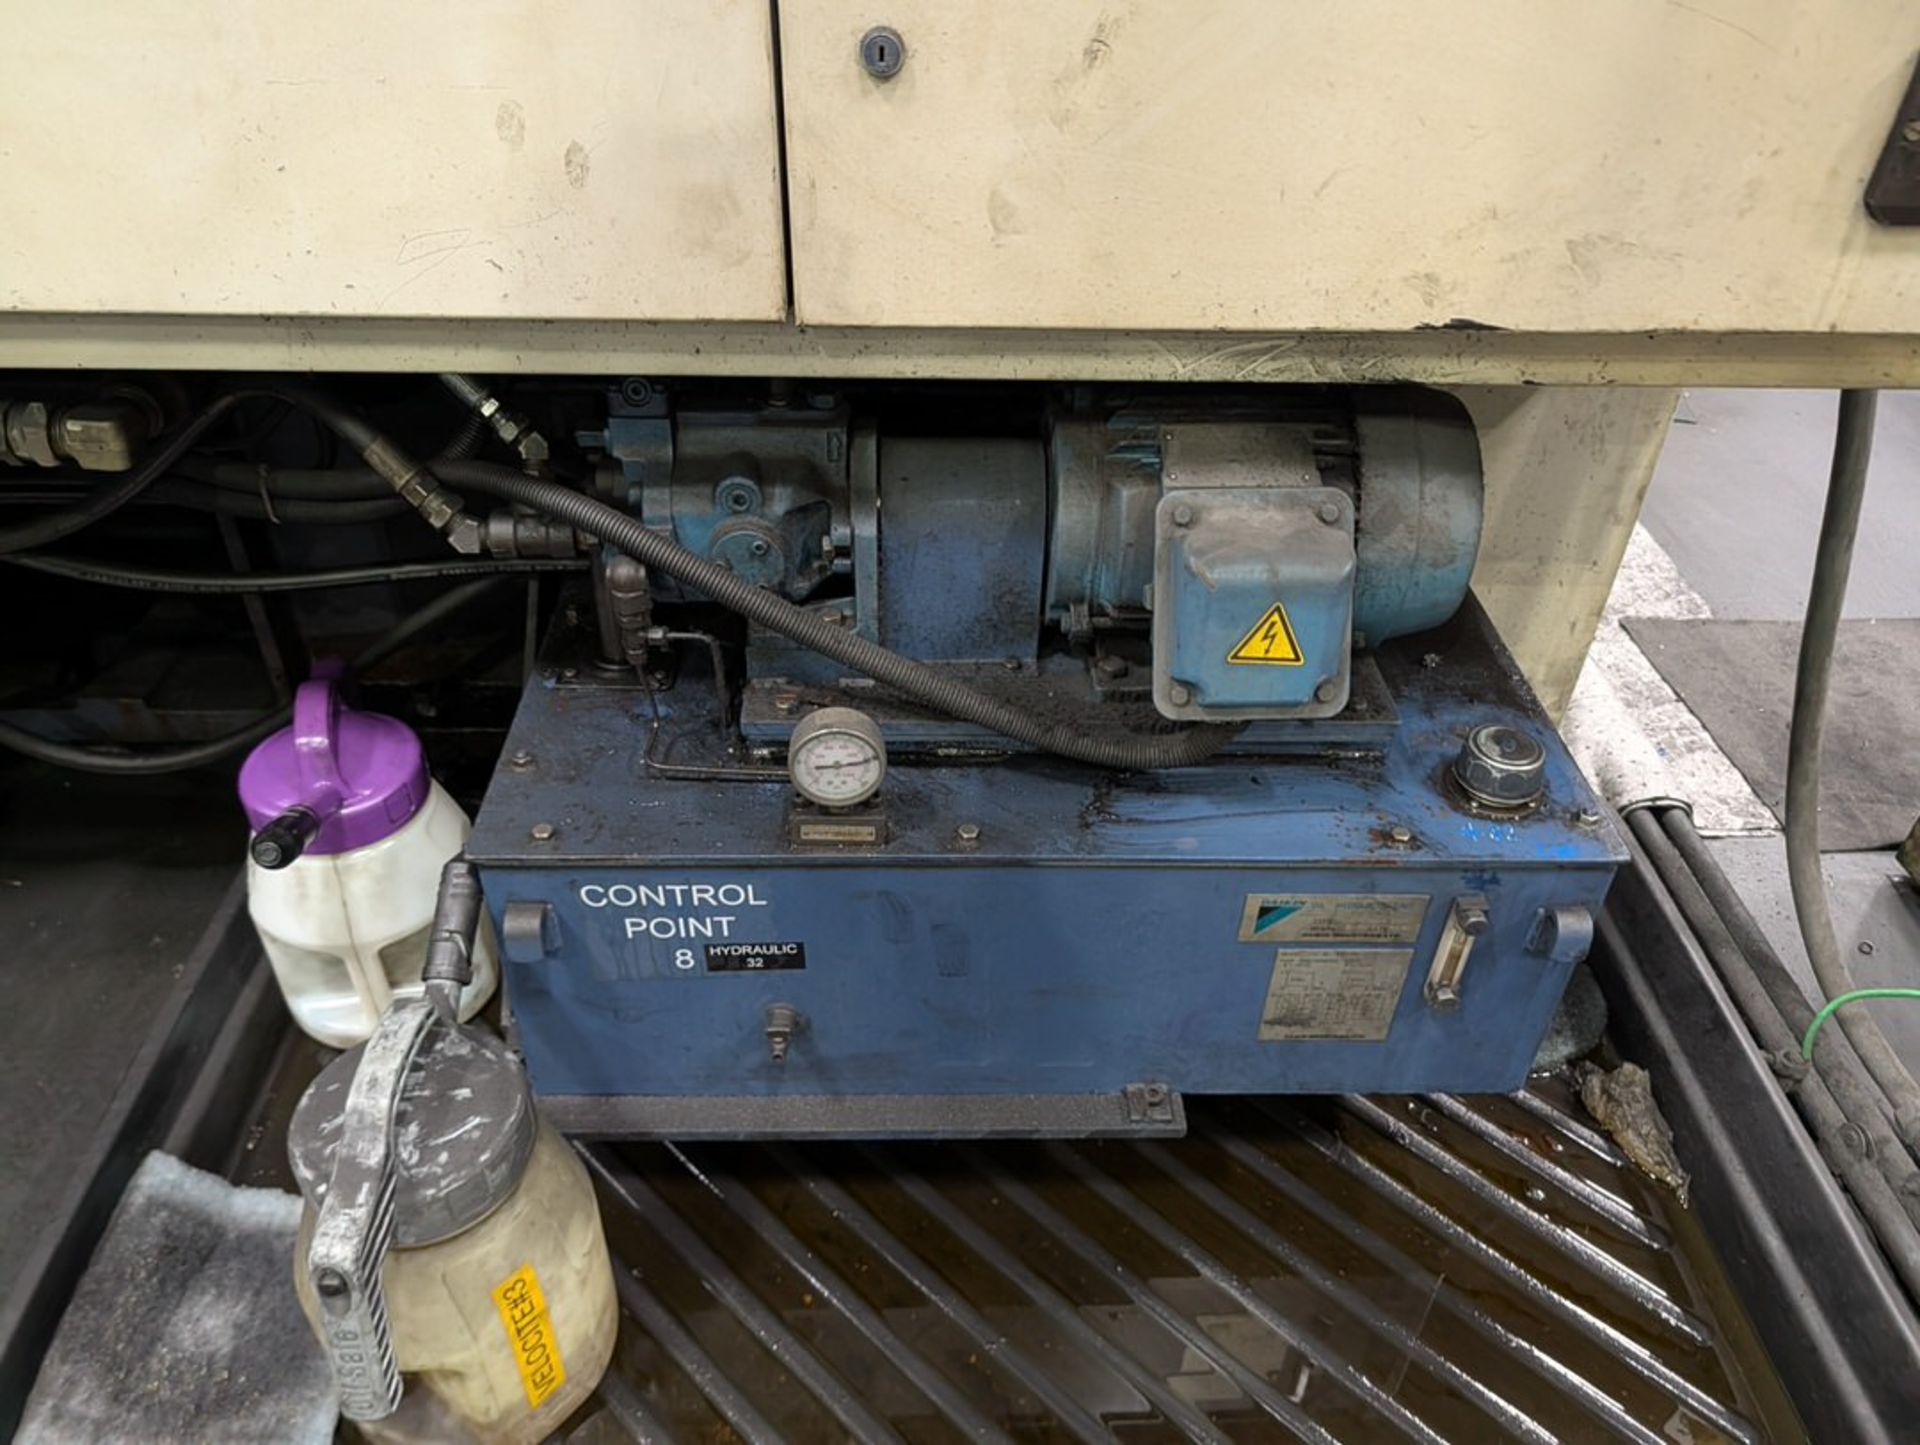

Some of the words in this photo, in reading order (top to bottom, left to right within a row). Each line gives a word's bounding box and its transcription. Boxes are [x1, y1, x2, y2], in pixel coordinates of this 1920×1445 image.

[580, 884, 768, 908] CONTROL
[624, 916, 736, 939] POINT
[675, 948, 695, 969] 8
[709, 943, 798, 956] HYDRAULIC
[746, 957, 764, 968] 32
